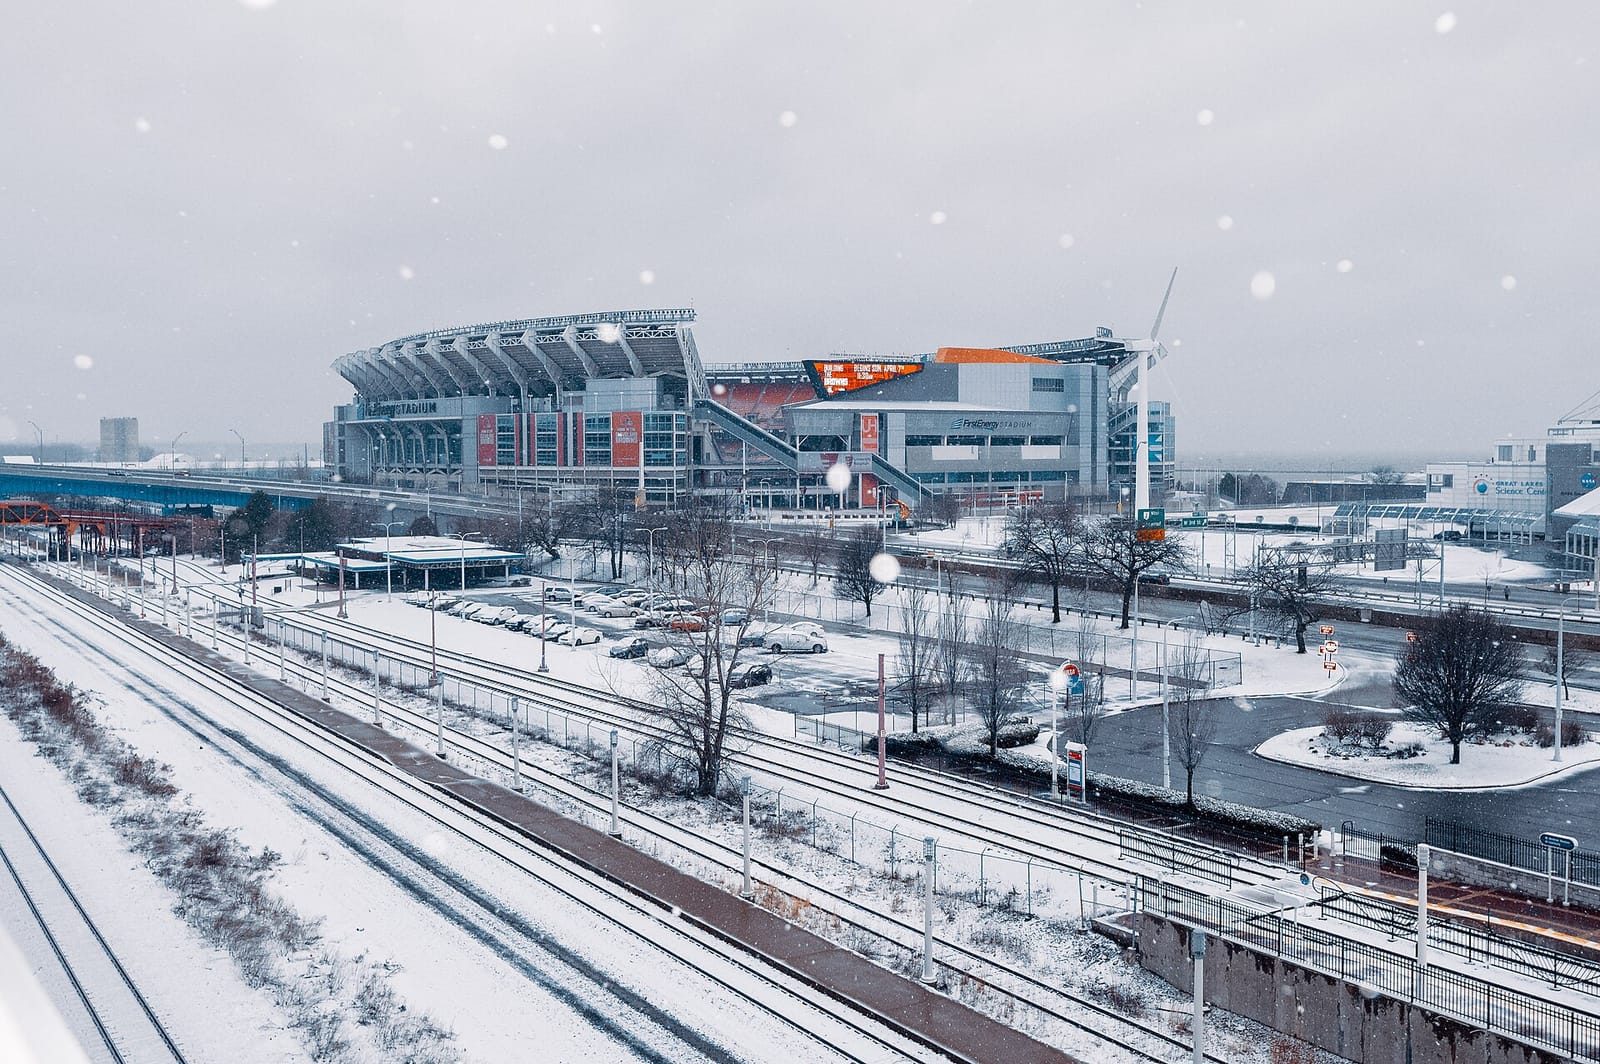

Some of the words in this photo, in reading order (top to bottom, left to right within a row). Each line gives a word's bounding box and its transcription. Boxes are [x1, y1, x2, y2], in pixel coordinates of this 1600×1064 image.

[824, 378, 848, 386] BROWNS
[396, 402, 437, 415] STADIUM
[963, 419, 1000, 429] FirstEnergy
[1495, 486, 1524, 495] Science
